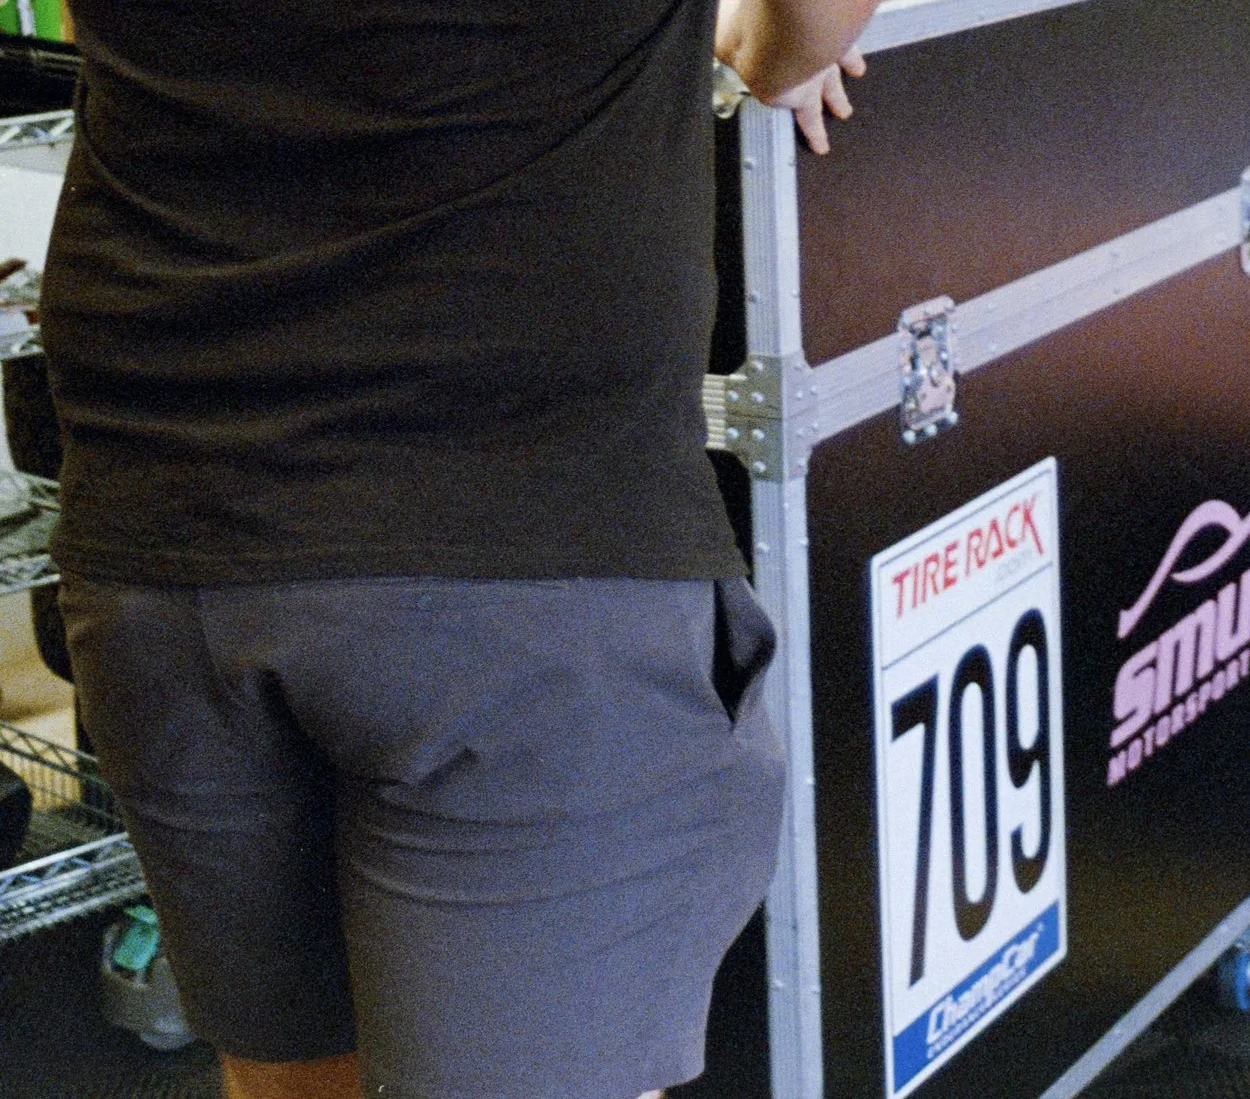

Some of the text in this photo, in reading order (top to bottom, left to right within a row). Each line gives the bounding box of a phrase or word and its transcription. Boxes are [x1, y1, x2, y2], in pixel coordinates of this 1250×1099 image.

[891, 493, 1045, 619] TIRE RACK
[1107, 649, 1250, 787] MOTORSPORT
[890, 608, 1052, 989] 709
